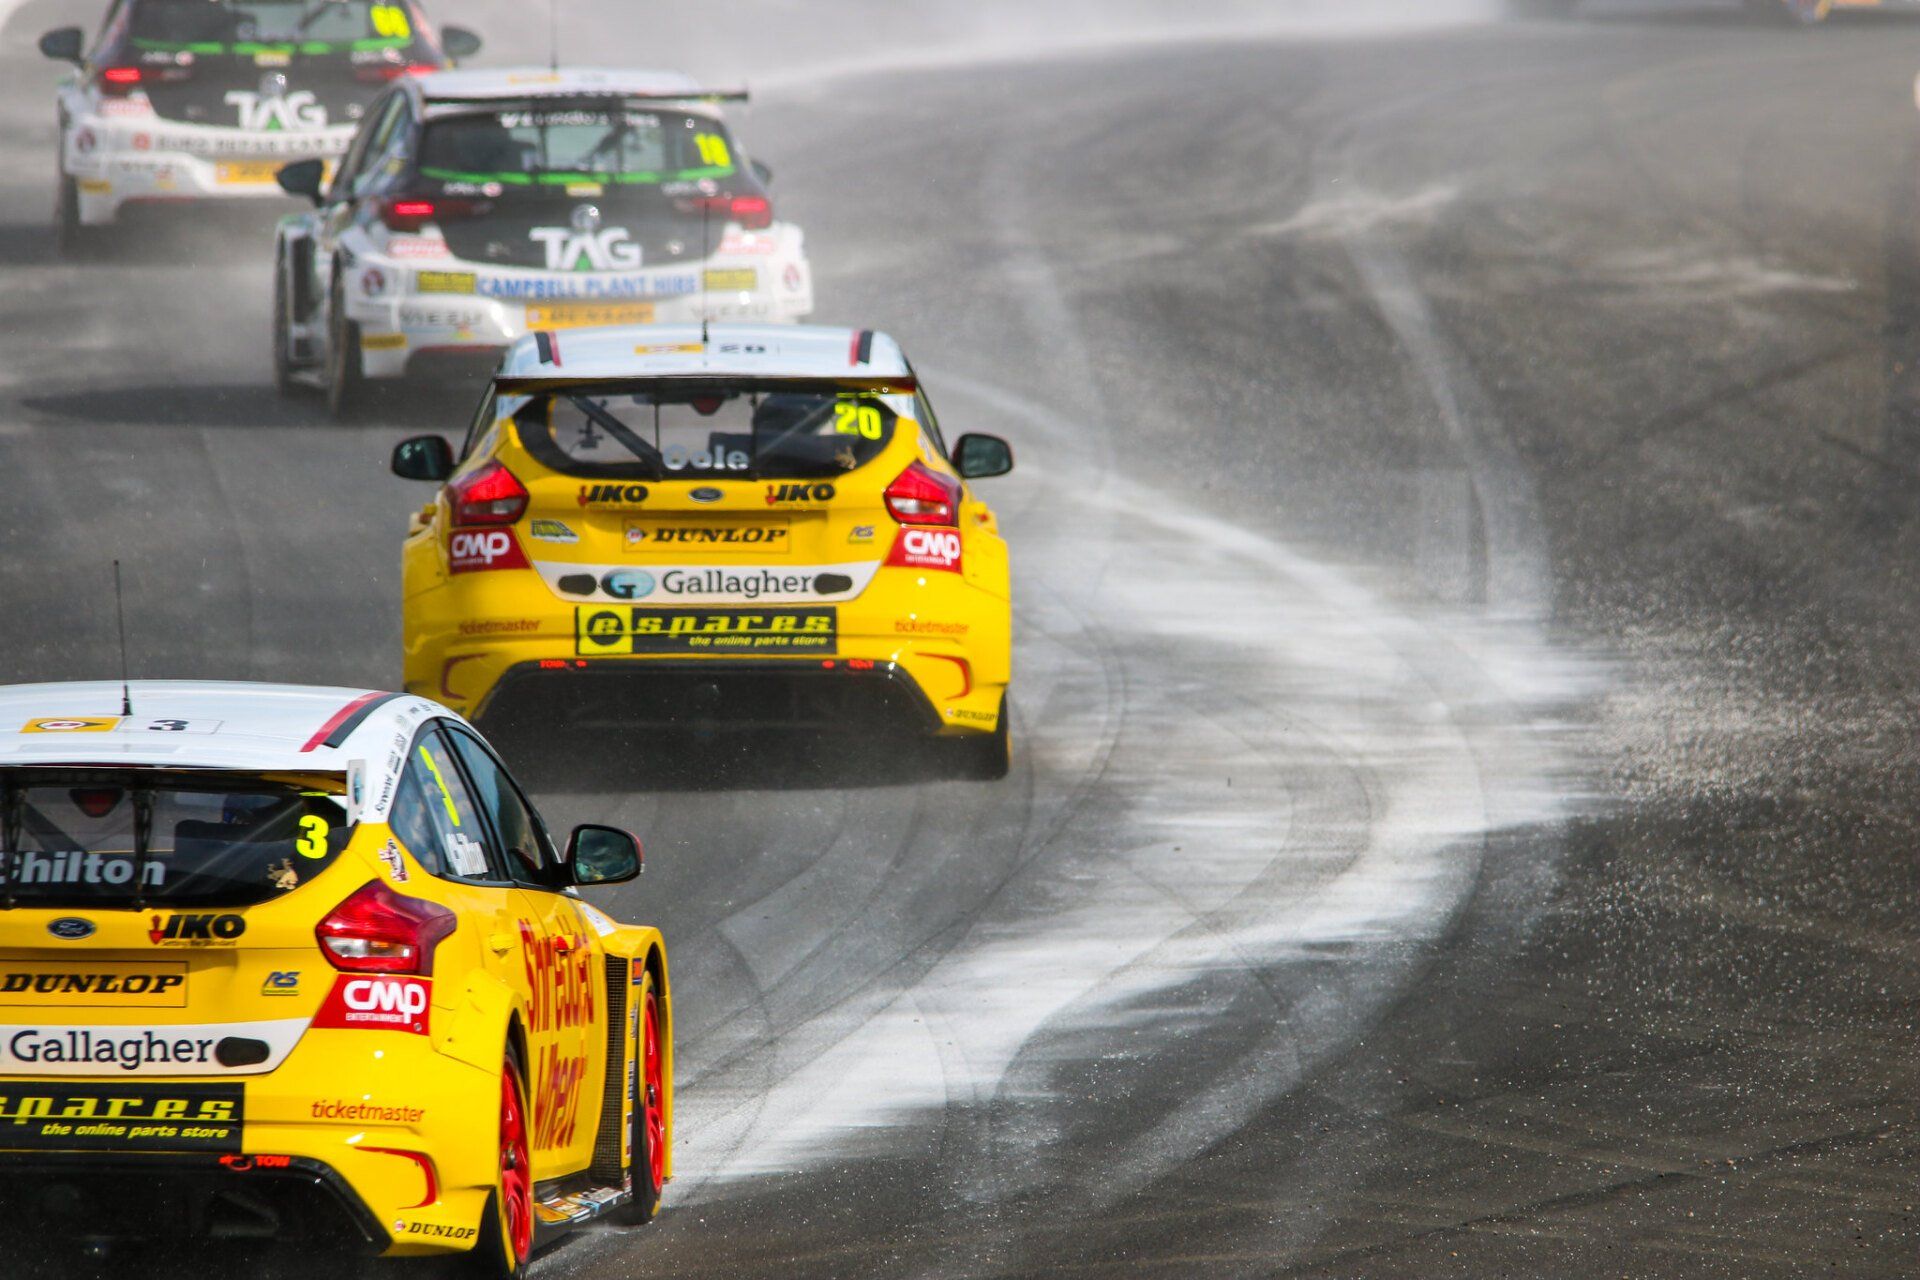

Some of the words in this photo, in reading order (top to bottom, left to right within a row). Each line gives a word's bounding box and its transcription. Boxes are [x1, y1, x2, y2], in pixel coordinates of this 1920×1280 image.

[225, 91, 327, 130] TAG
[529, 227, 642, 271] TAG
[477, 277, 578, 299] CAMPBELL
[585, 276, 646, 297] PLANT
[653, 274, 697, 294] HIRE
[834, 401, 882, 440] 20
[654, 528, 787, 543] DUNLOP
[662, 570, 816, 598] Gallagher
[894, 620, 970, 634] ticketmaster
[689, 636, 710, 646] the
[713, 636, 752, 646] online
[754, 636, 789, 648] parts
[791, 636, 828, 646] store
[149, 719, 189, 731] 3
[296, 814, 329, 859] 3
[0, 973, 184, 994] DUNLOP
[10, 1030, 213, 1070] Gallagher
[311, 1100, 425, 1123] ticketmaster
[41, 1122, 72, 1136] the
[75, 1122, 125, 1137] online
[128, 1124, 177, 1139] parts
[181, 1127, 229, 1138] store
[254, 1155, 290, 1167] TOW
[409, 1222, 476, 1240] DUNLOP
